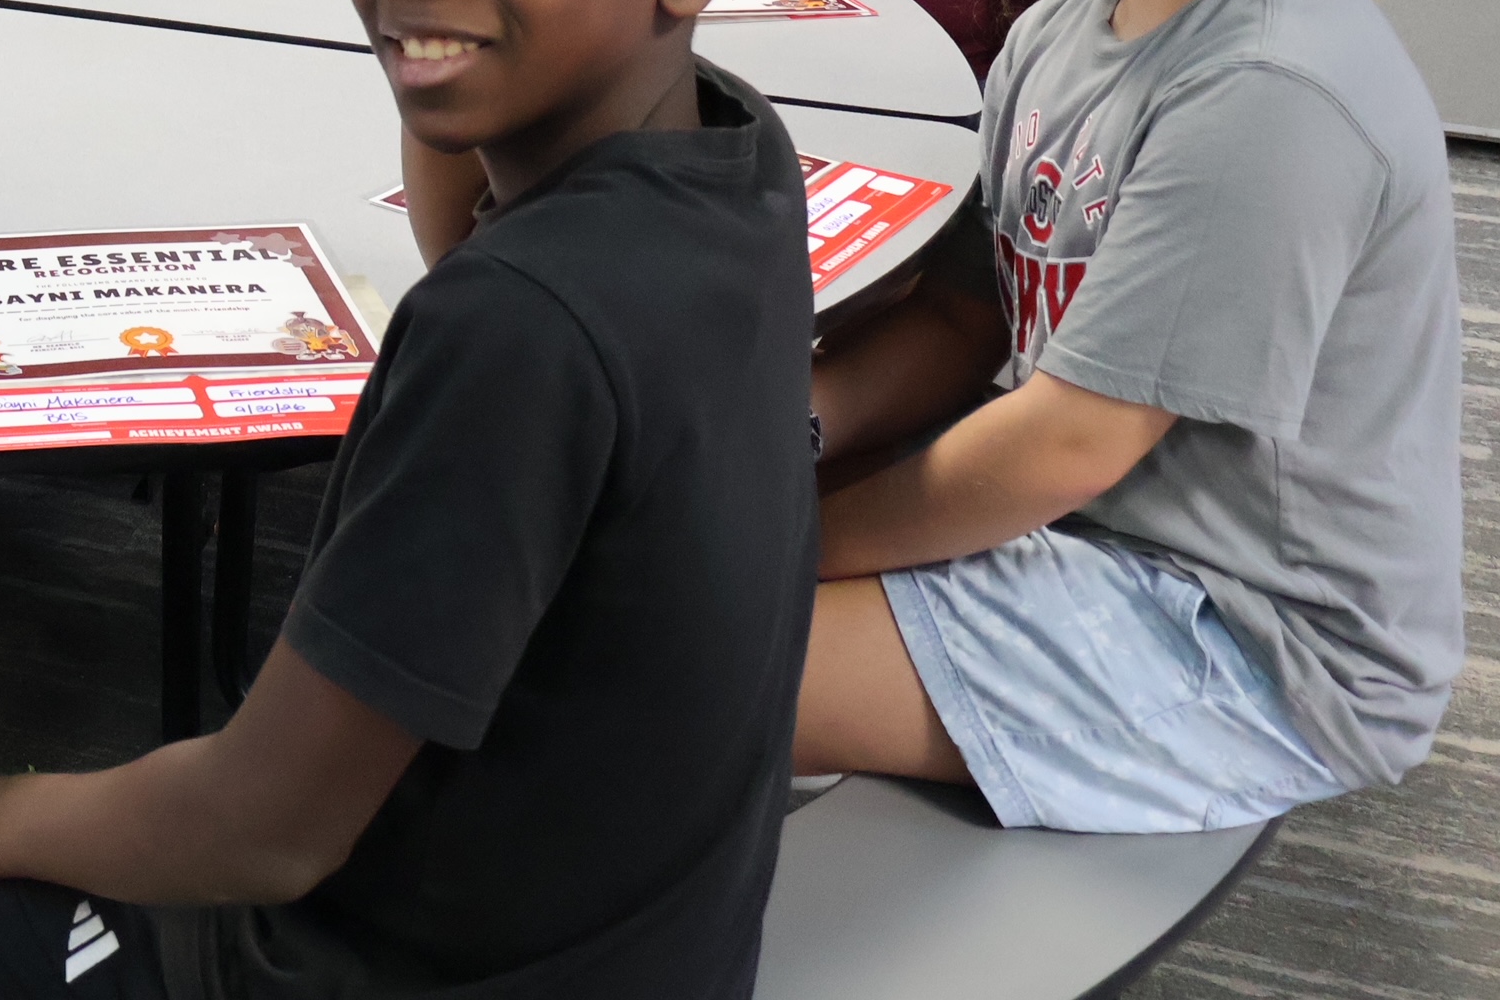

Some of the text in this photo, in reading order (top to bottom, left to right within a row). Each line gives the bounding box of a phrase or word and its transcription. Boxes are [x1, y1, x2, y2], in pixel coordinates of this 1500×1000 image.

[56, 248, 279, 268] ESSENTIAL
[33, 264, 197, 278] RECOGNITION
[93, 283, 267, 299] MAKANERA
[229, 387, 318, 398] Friendship
[46, 395, 143, 410] Makanera
[235, 403, 306, 414] 9/30/26
[44, 412, 88, 422] BCIS
[129, 422, 304, 438] ACHIEVEMENT AWARD
